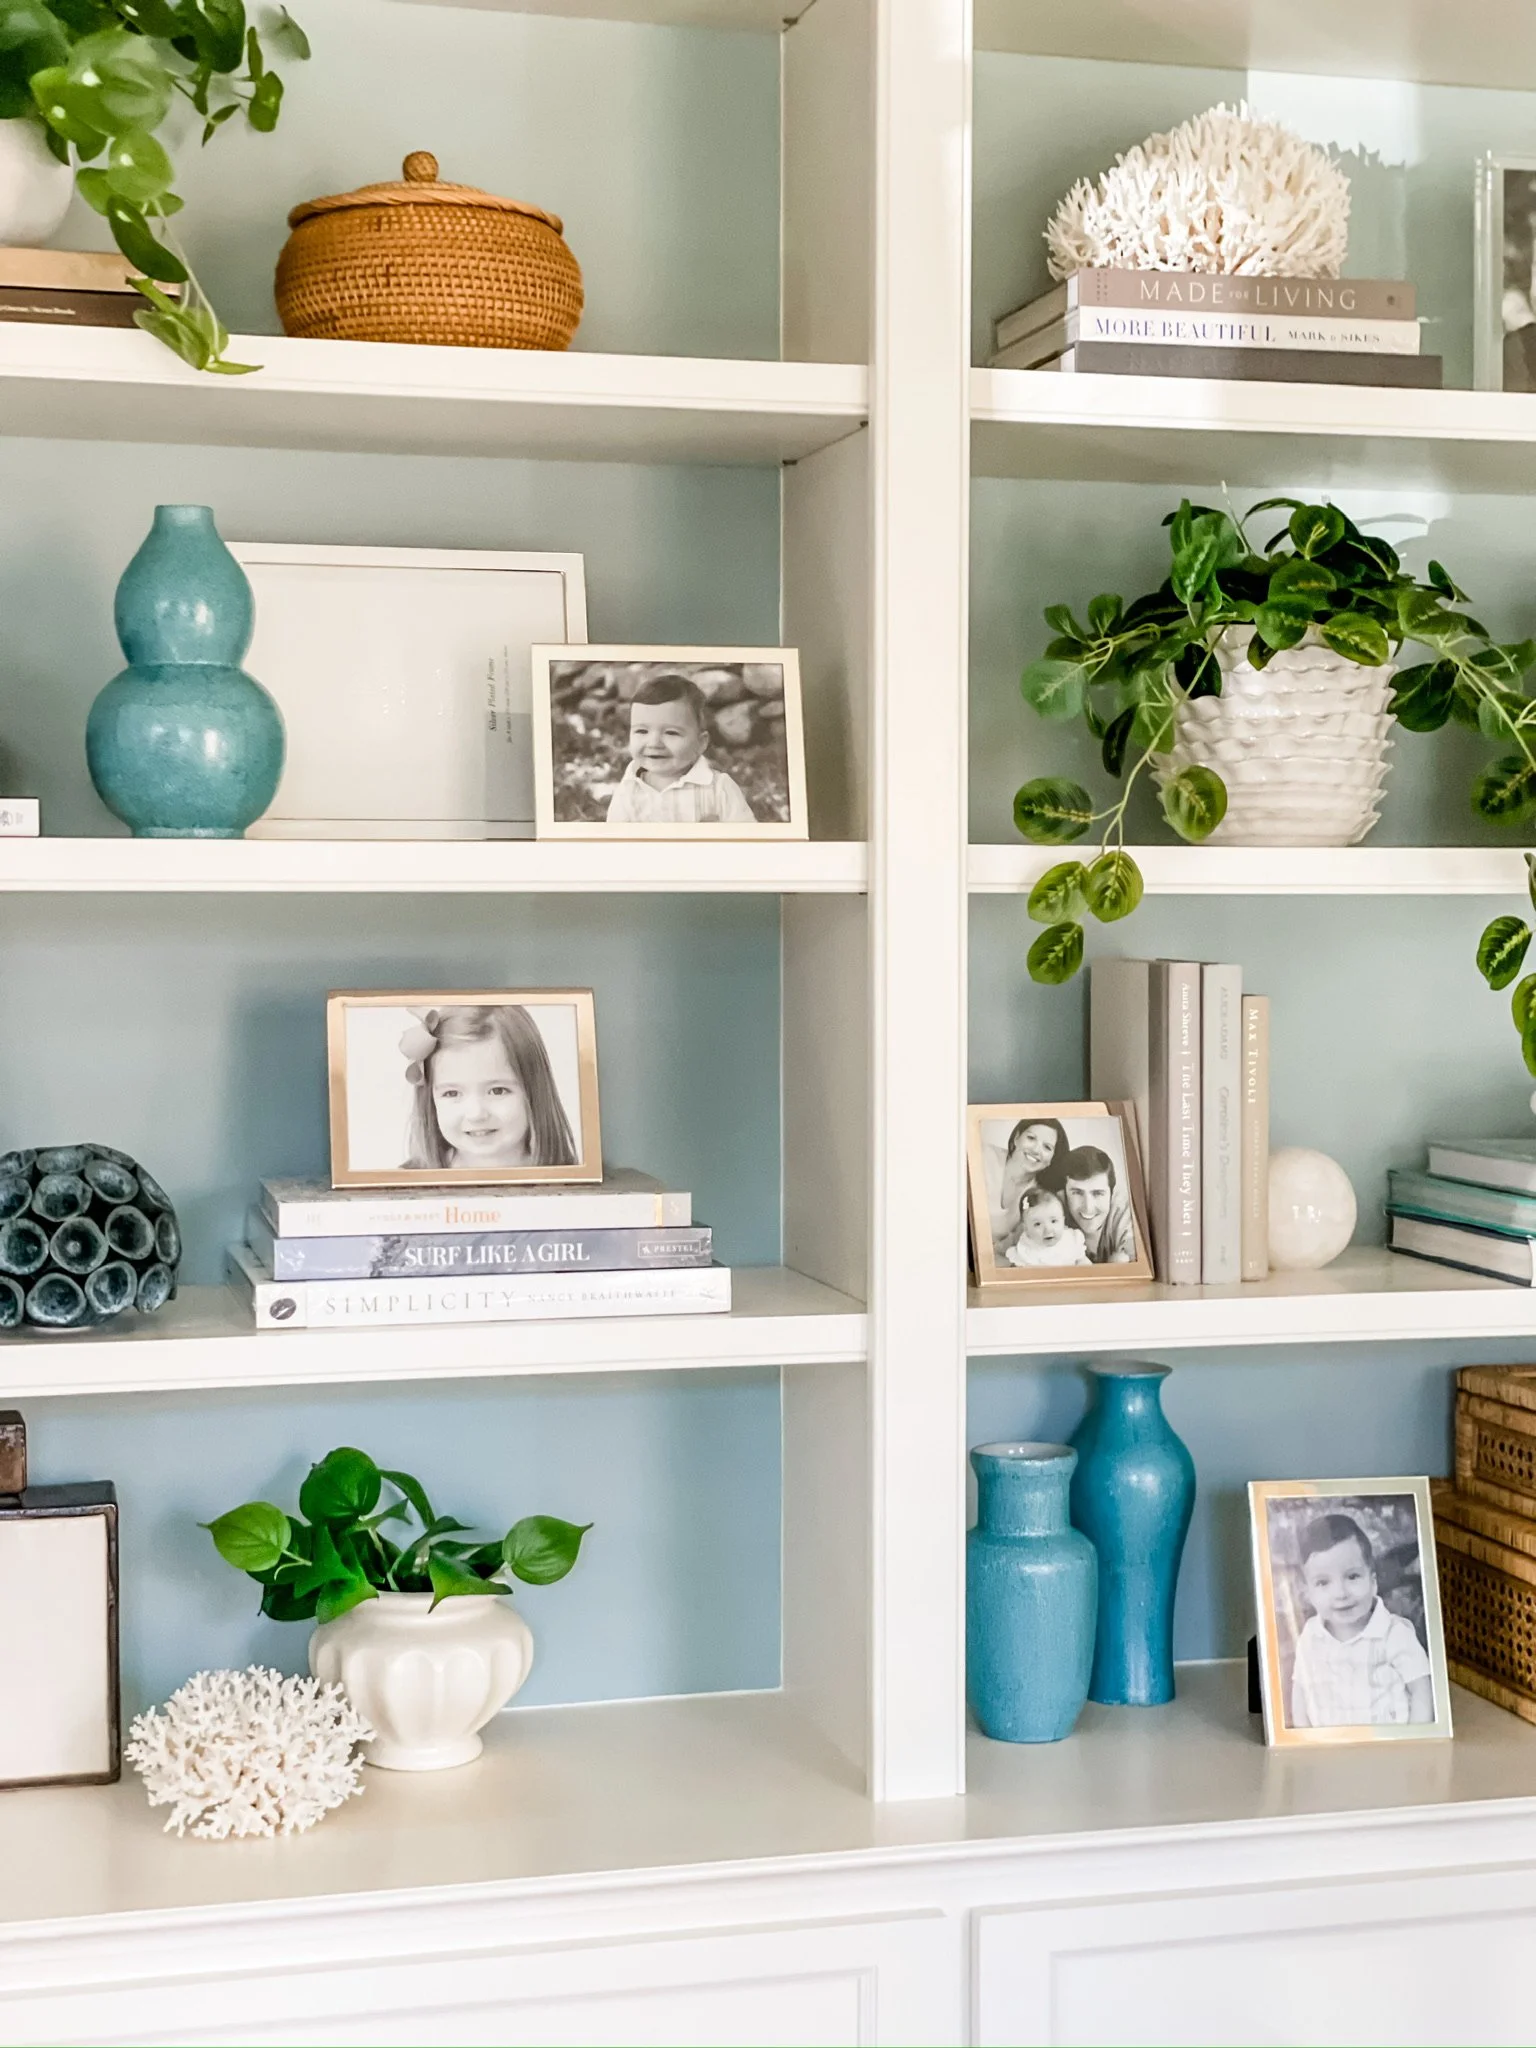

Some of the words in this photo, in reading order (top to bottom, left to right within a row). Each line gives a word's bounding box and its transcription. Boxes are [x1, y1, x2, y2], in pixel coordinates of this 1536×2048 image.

[1139, 279, 1225, 305] MADE
[1228, 290, 1250, 301] FOR
[1255, 286, 1357, 311] LIVING
[1095, 317, 1155, 337] MORE
[1161, 320, 1277, 343] BEAUTIFUL
[1288, 329, 1327, 342] MARK
[1340, 333, 1381, 344] SIKES
[1181, 1011, 1192, 1047] Shreve
[1247, 1008, 1259, 1042] MAX
[1181, 1062, 1195, 1089] The
[1247, 1048, 1259, 1105] TIVOLI
[1181, 1092, 1195, 1120] Last
[1181, 1122, 1195, 1157] Time
[1179, 1160, 1195, 1196] They
[444, 1205, 502, 1225] Home
[1181, 1199, 1195, 1225] Met
[403, 1245, 461, 1268] SURF
[465, 1243, 518, 1265] LIKE
[521, 1244, 537, 1264] A
[537, 1241, 591, 1262] GIRL
[653, 1243, 694, 1254] PRESTEL
[324, 1290, 517, 1315] SIMPLICITY
